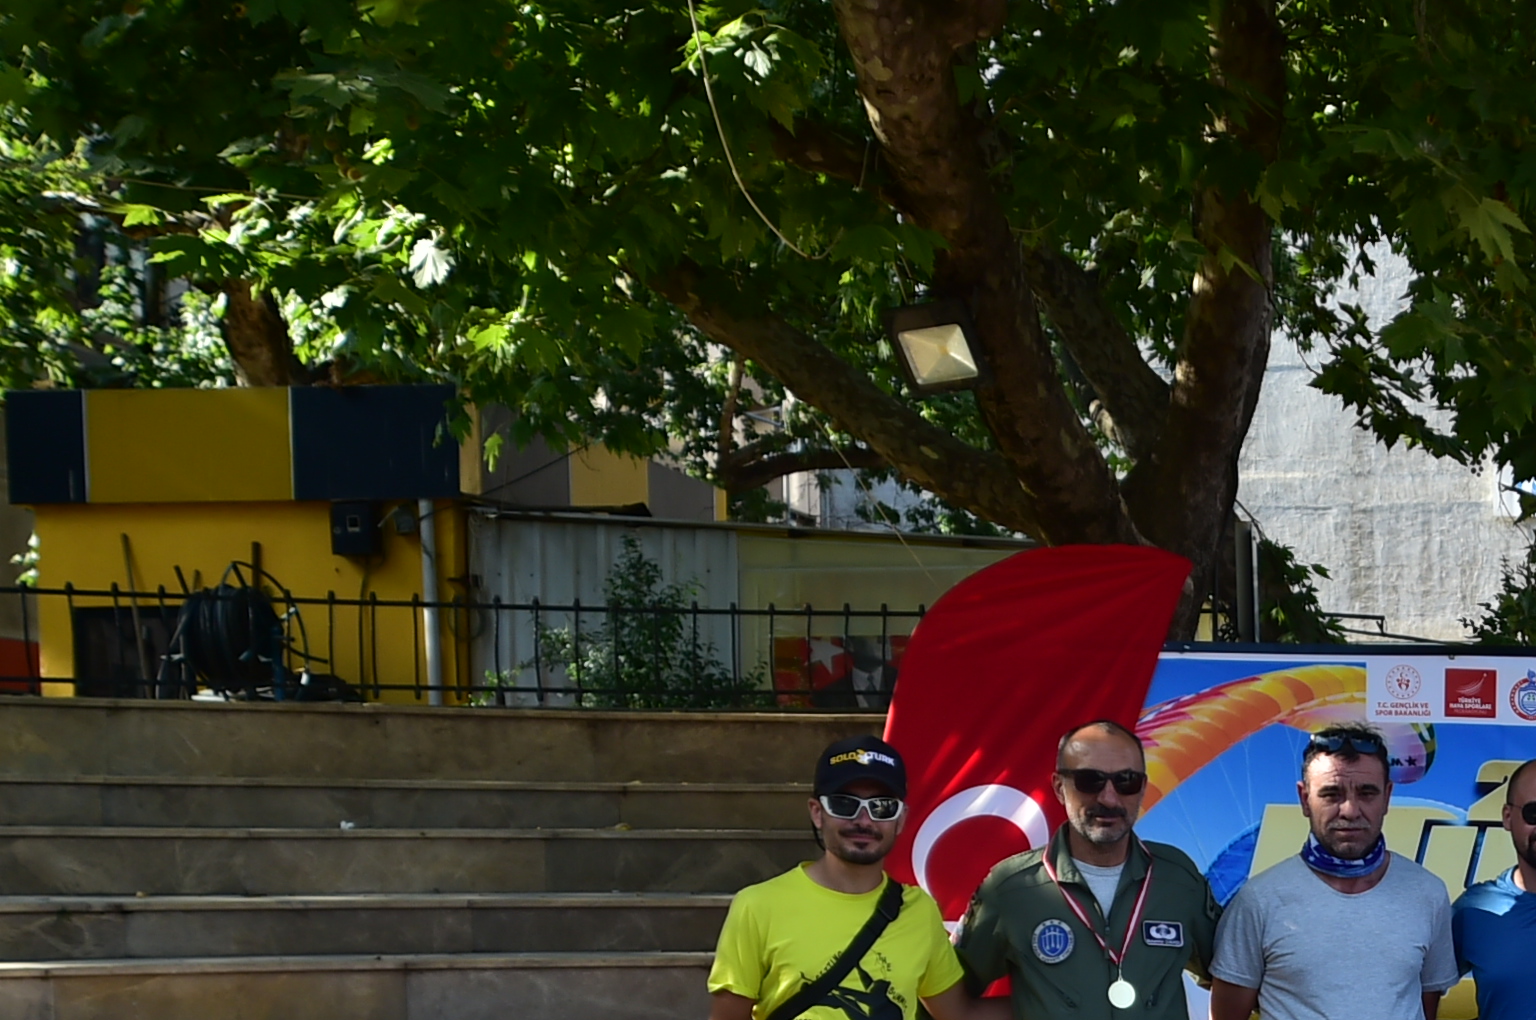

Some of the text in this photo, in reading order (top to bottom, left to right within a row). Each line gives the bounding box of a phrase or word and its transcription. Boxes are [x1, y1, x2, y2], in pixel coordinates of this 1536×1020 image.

[1390, 702, 1420, 710] GENÇLİK
[1394, 709, 1431, 717] BAKANLIĞI
[829, 751, 857, 765] SOLO
